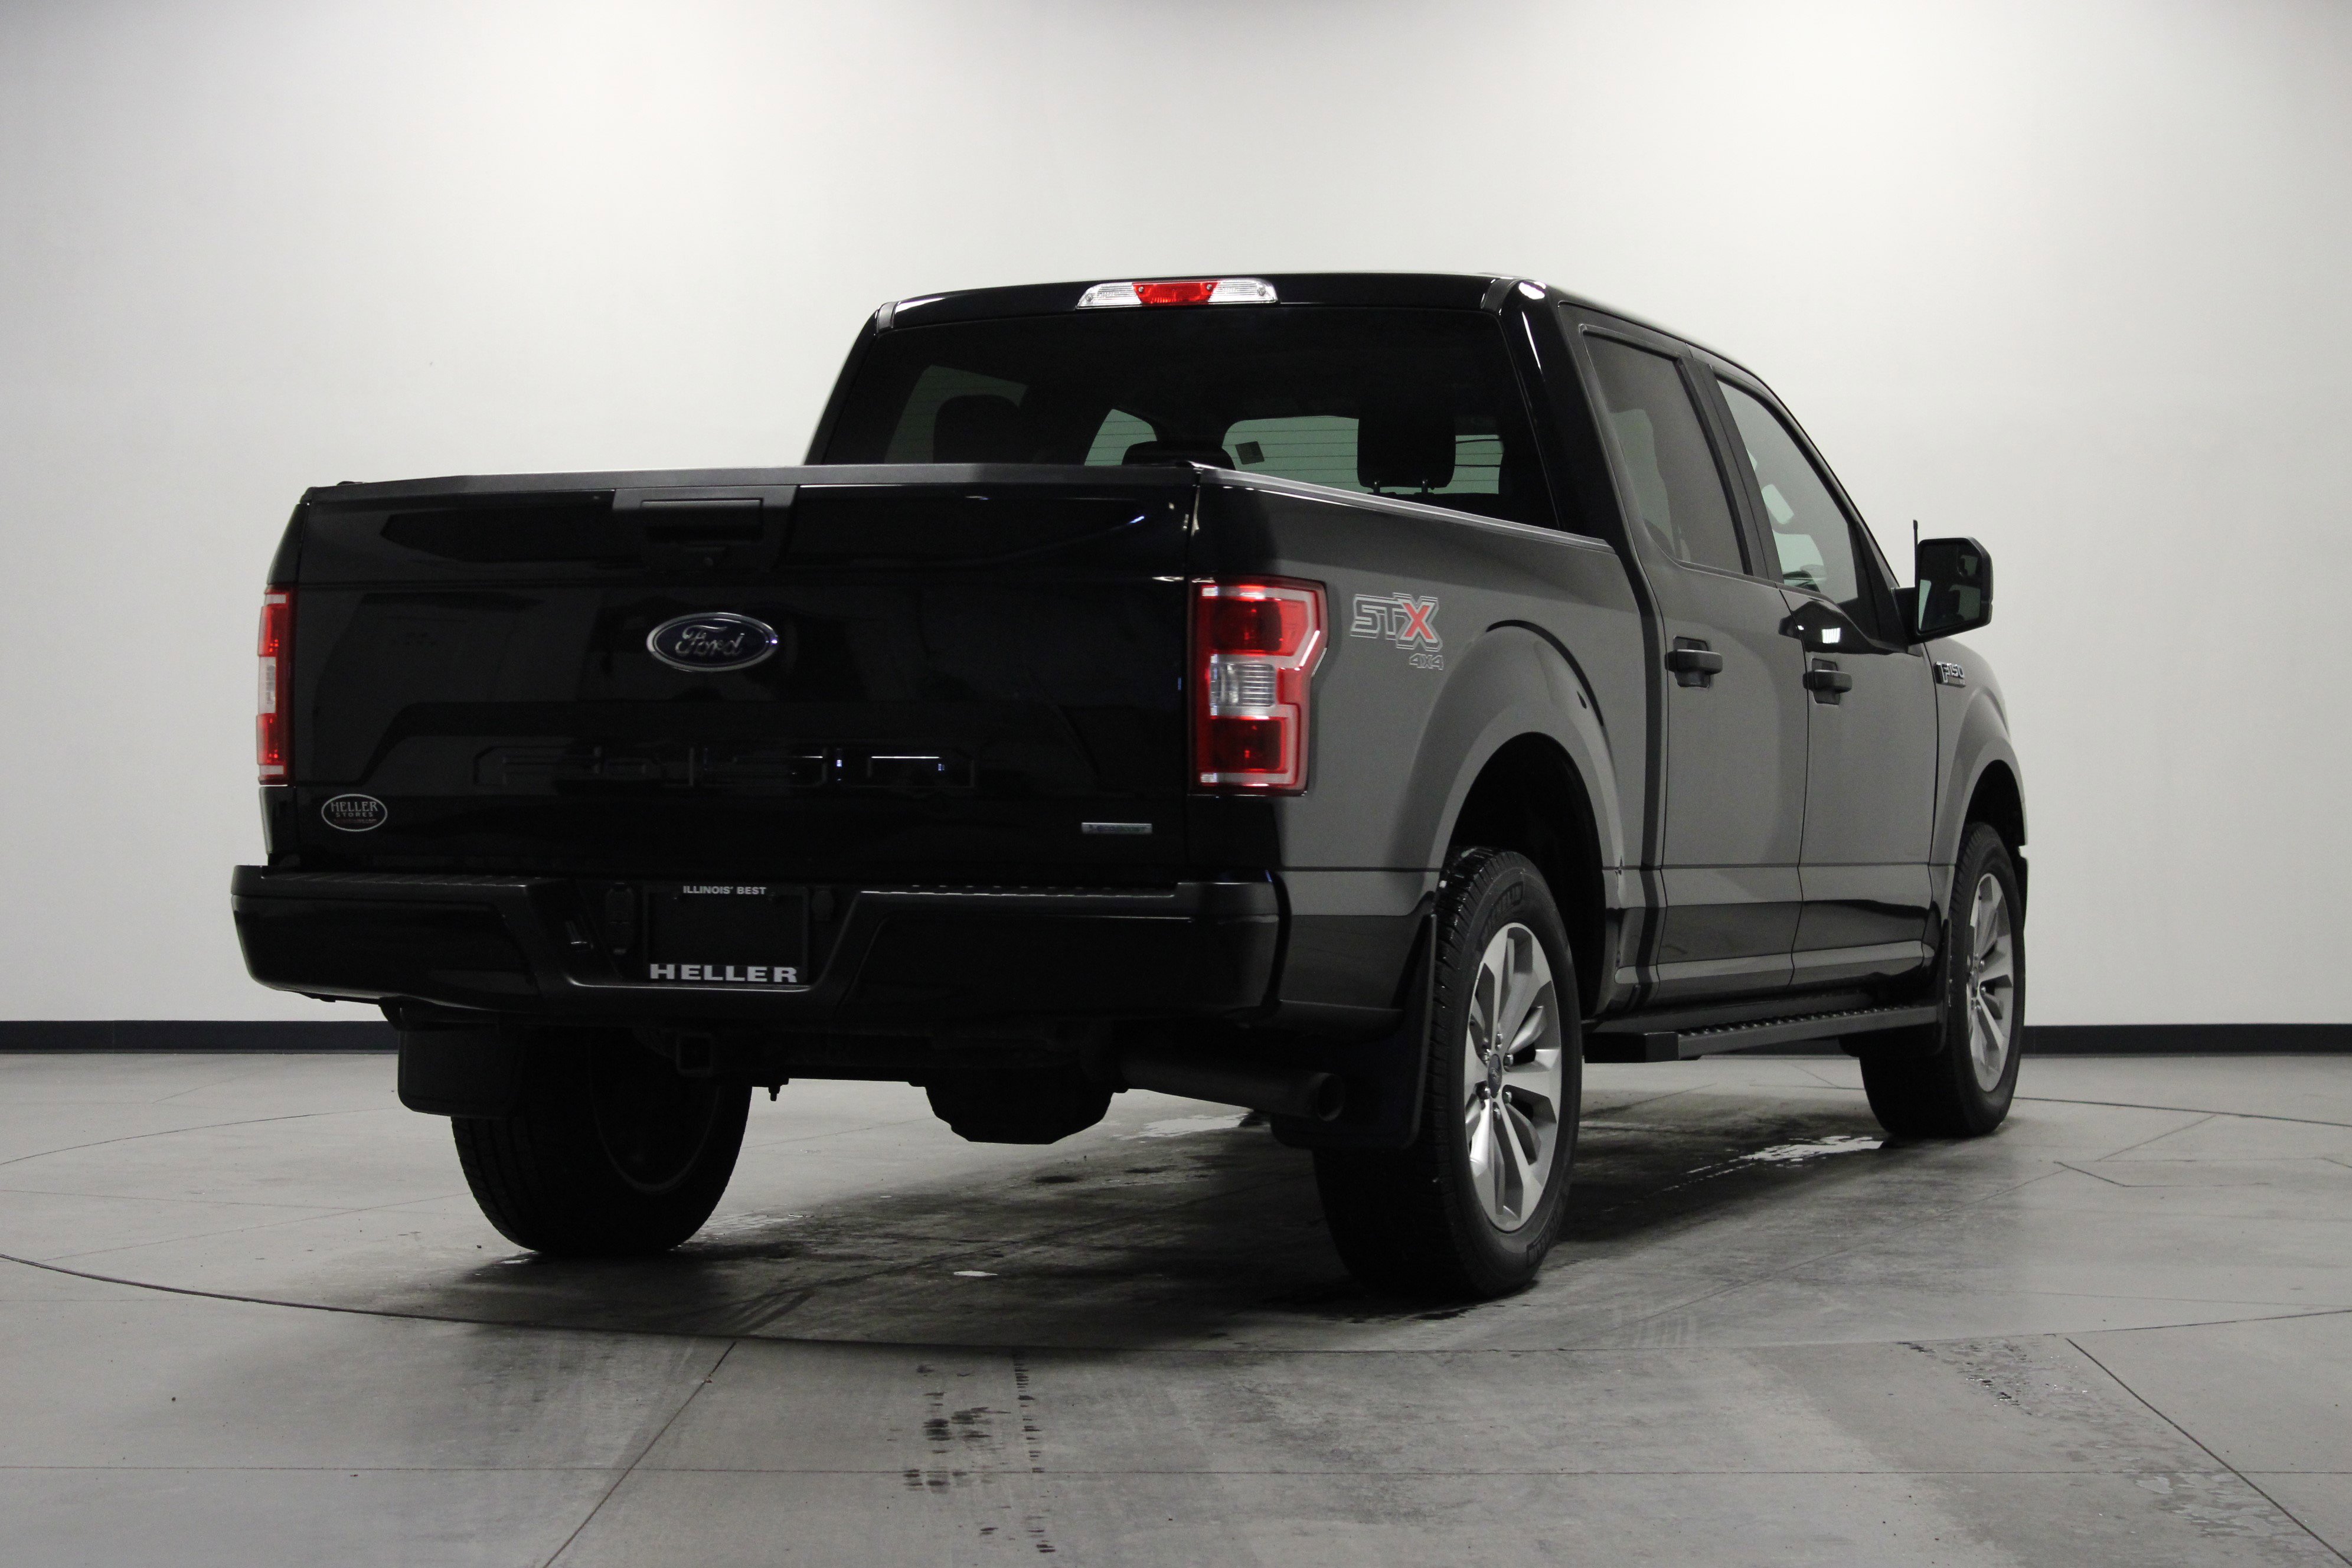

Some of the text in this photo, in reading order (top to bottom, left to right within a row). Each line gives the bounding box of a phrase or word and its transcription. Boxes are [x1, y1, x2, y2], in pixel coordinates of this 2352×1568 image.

[1350, 592, 1443, 652] STX
[674, 624, 746, 656] Ford
[331, 801, 378, 812] HELLER
[737, 886, 766, 894] BEST
[650, 963, 798, 983] HELLER
